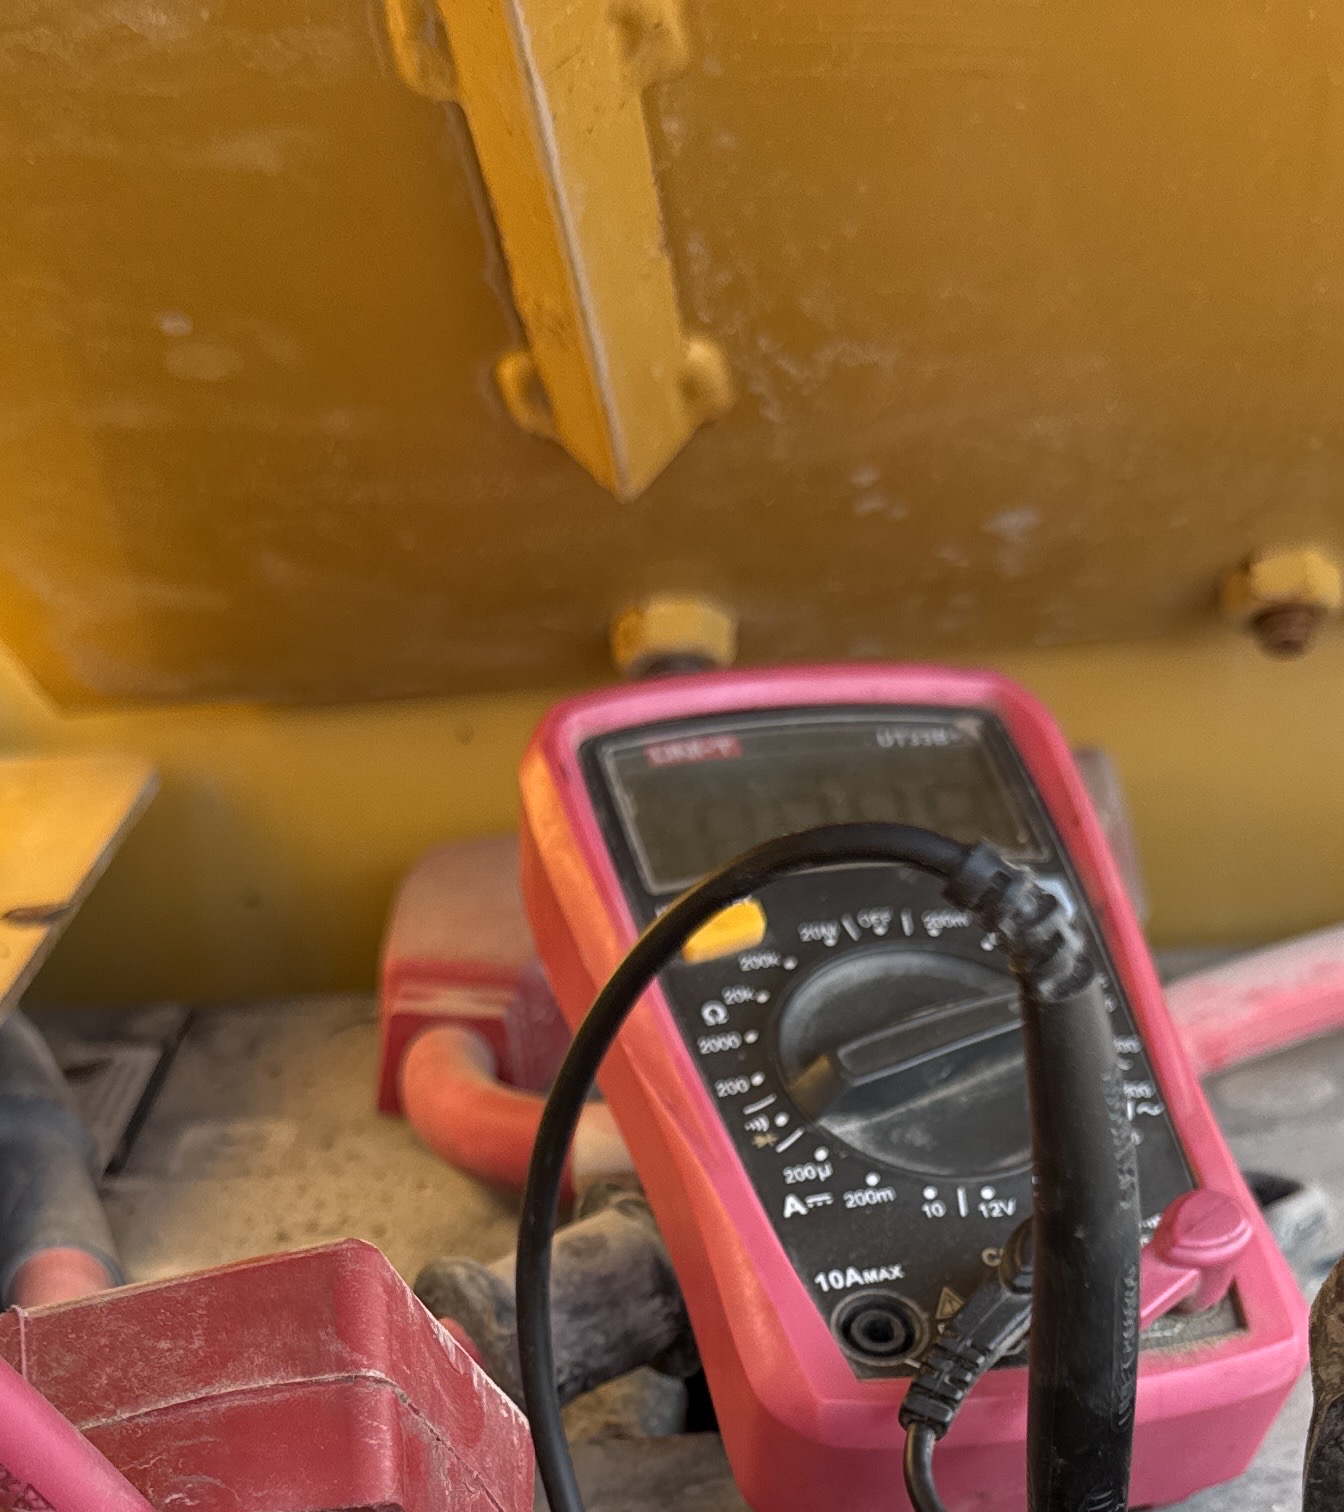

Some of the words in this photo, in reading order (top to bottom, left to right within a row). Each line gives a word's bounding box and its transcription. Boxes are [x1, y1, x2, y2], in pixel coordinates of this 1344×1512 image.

[698, 1031, 742, 1054] 2000
[714, 1076, 750, 1098] 200
[843, 1188, 896, 1209] 200m
[977, 1199, 1017, 1219] 12V
[922, 1203, 947, 1219] 10
